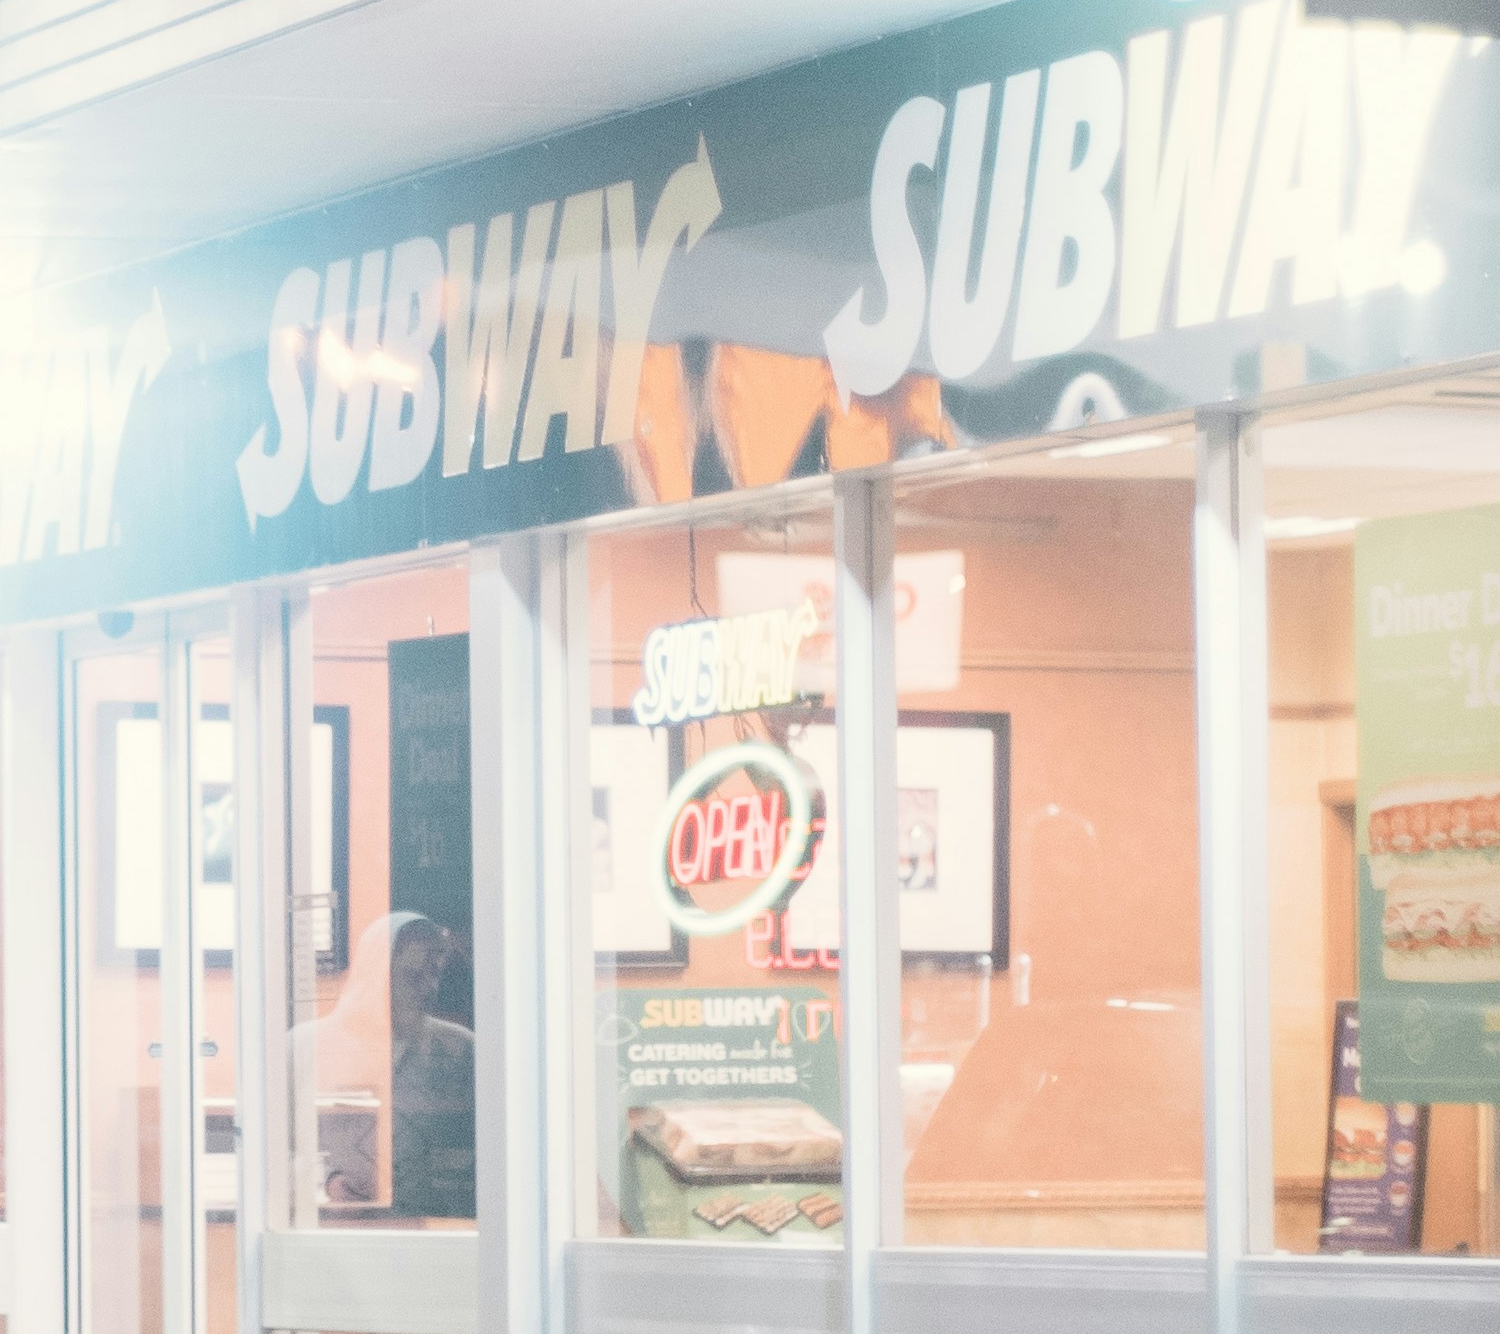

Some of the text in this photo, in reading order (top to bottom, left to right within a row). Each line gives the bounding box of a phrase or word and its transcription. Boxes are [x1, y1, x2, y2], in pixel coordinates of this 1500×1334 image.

[236, 130, 723, 536] SUBWAY
[1369, 581, 1472, 639] Dinner
[635, 597, 818, 727] SUBWAY
[671, 791, 781, 885] OPEN
[639, 995, 784, 1030] SUBWAY
[627, 1042, 727, 1062] CATERING
[629, 1065, 798, 1086] GET TOGETHERS
